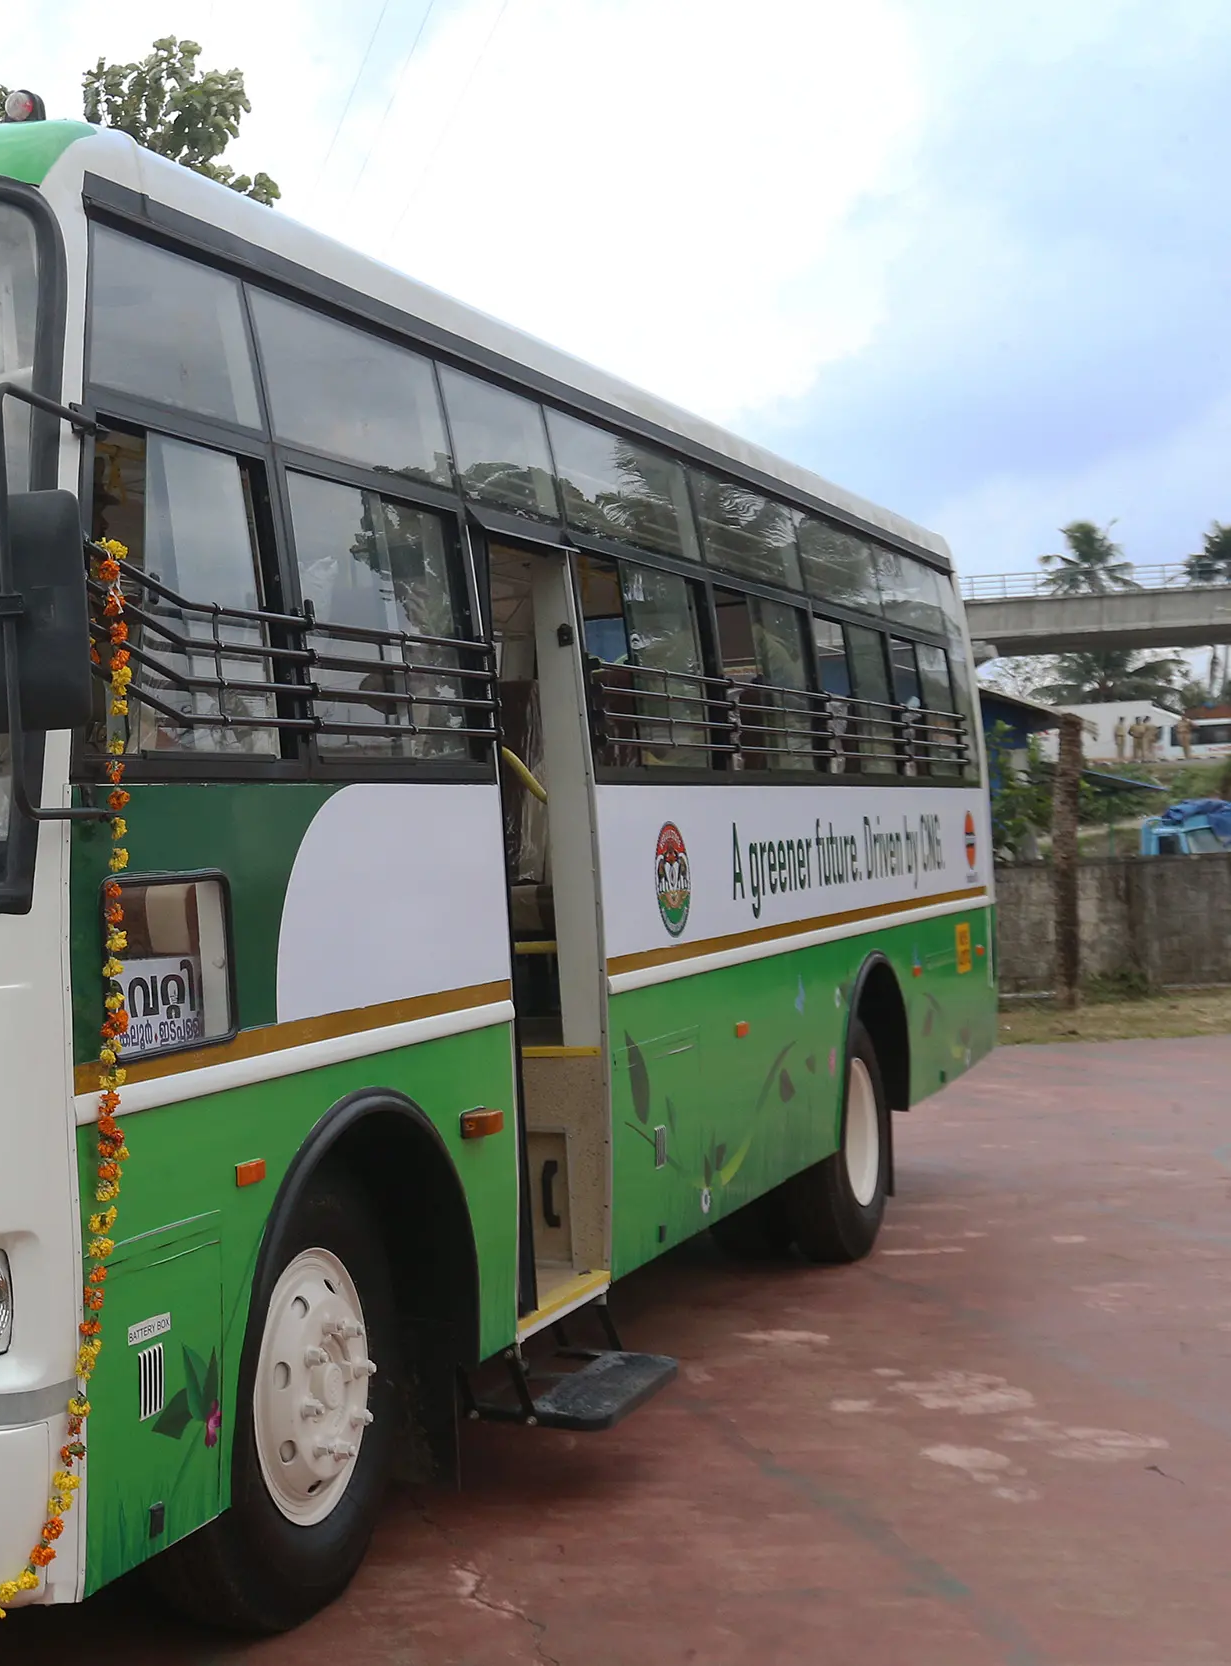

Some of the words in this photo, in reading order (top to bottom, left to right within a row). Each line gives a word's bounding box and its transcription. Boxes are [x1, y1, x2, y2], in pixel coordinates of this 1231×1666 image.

[732, 822, 745, 900] A
[749, 837, 812, 919] greener
[816, 818, 863, 887] future.
[863, 815, 903, 880] Driven
[903, 814, 918, 890] by
[129, 1322, 156, 1343] BATTERY
[157, 1317, 170, 1331] BOX
